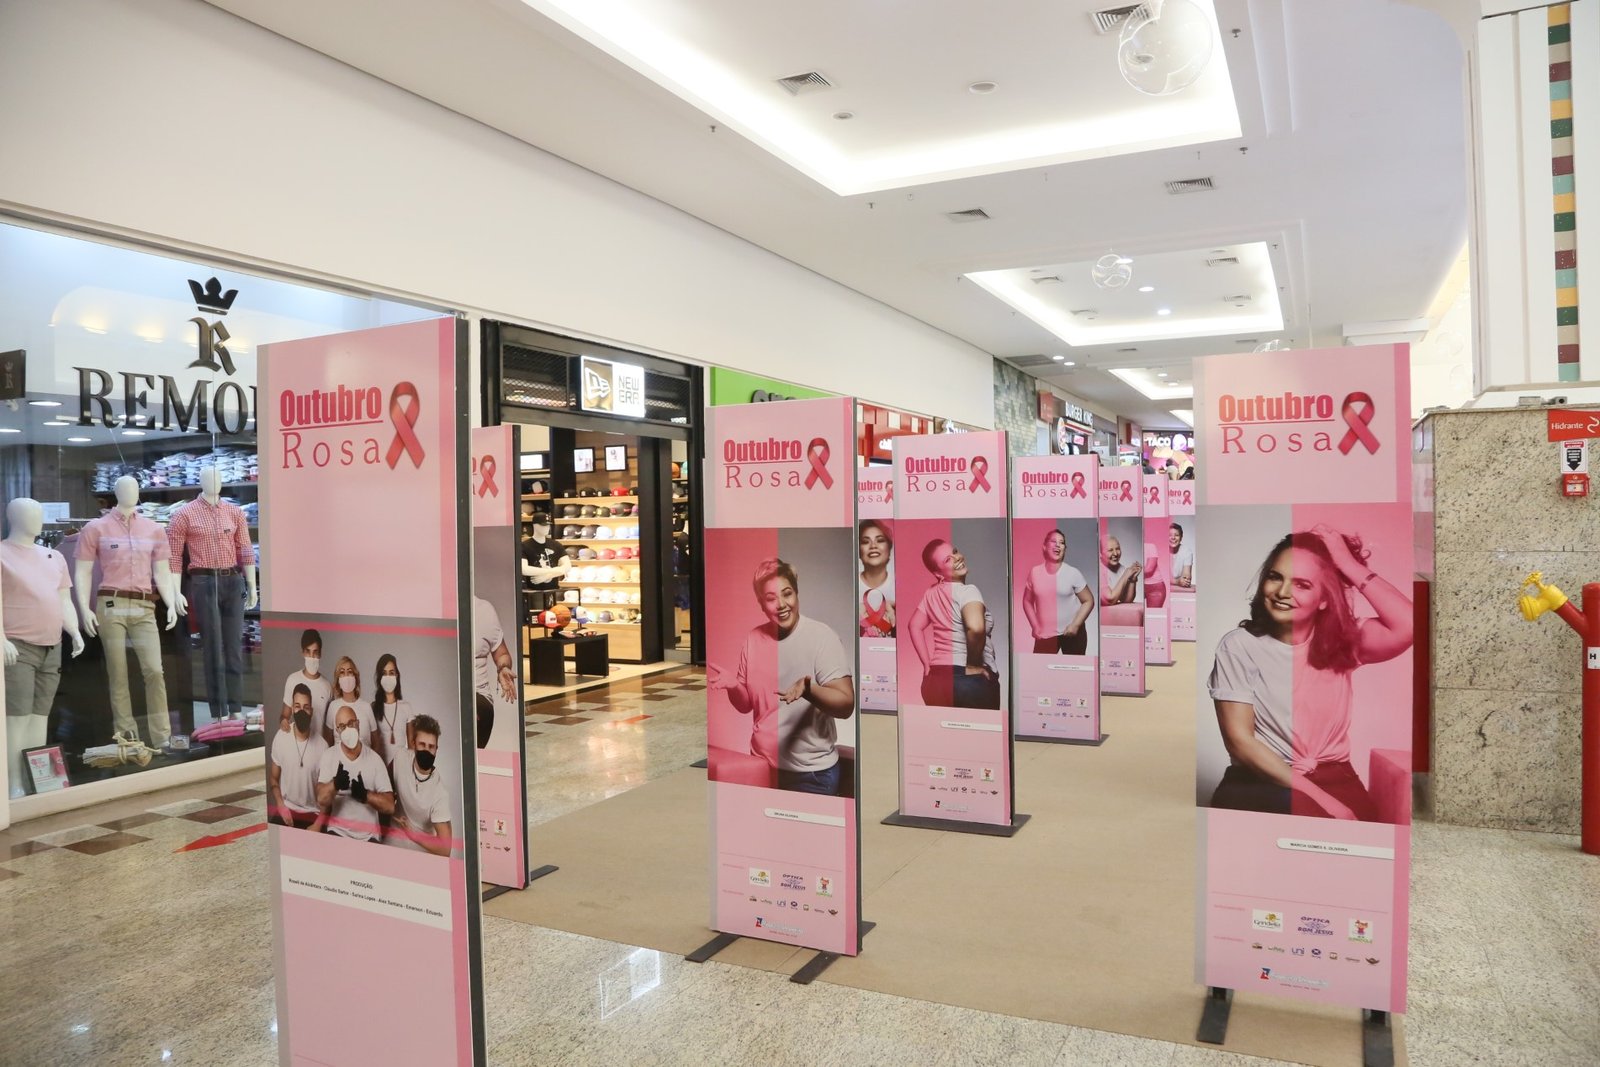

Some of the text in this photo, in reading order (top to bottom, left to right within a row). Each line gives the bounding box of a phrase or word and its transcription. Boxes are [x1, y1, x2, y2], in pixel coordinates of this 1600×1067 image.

[618, 375, 640, 391] NEW
[279, 384, 382, 427] Outubro
[618, 391, 640, 405] ERA
[1065, 401, 1083, 423] BURGER
[1218, 392, 1334, 422] Outubro
[1551, 422, 1584, 430] Hidrante
[1147, 436, 1171, 448] TACO
[1221, 426, 1332, 454] Rosa
[282, 431, 381, 469] Rosa
[723, 437, 803, 462] Outubro
[905, 456, 967, 473] Outubro
[725, 465, 801, 488] Rosa
[907, 475, 967, 492] Rosa
[1022, 471, 1069, 485] Outubro
[1023, 485, 1068, 498] Rosa
[1314, 928, 1334, 936] JESUS
